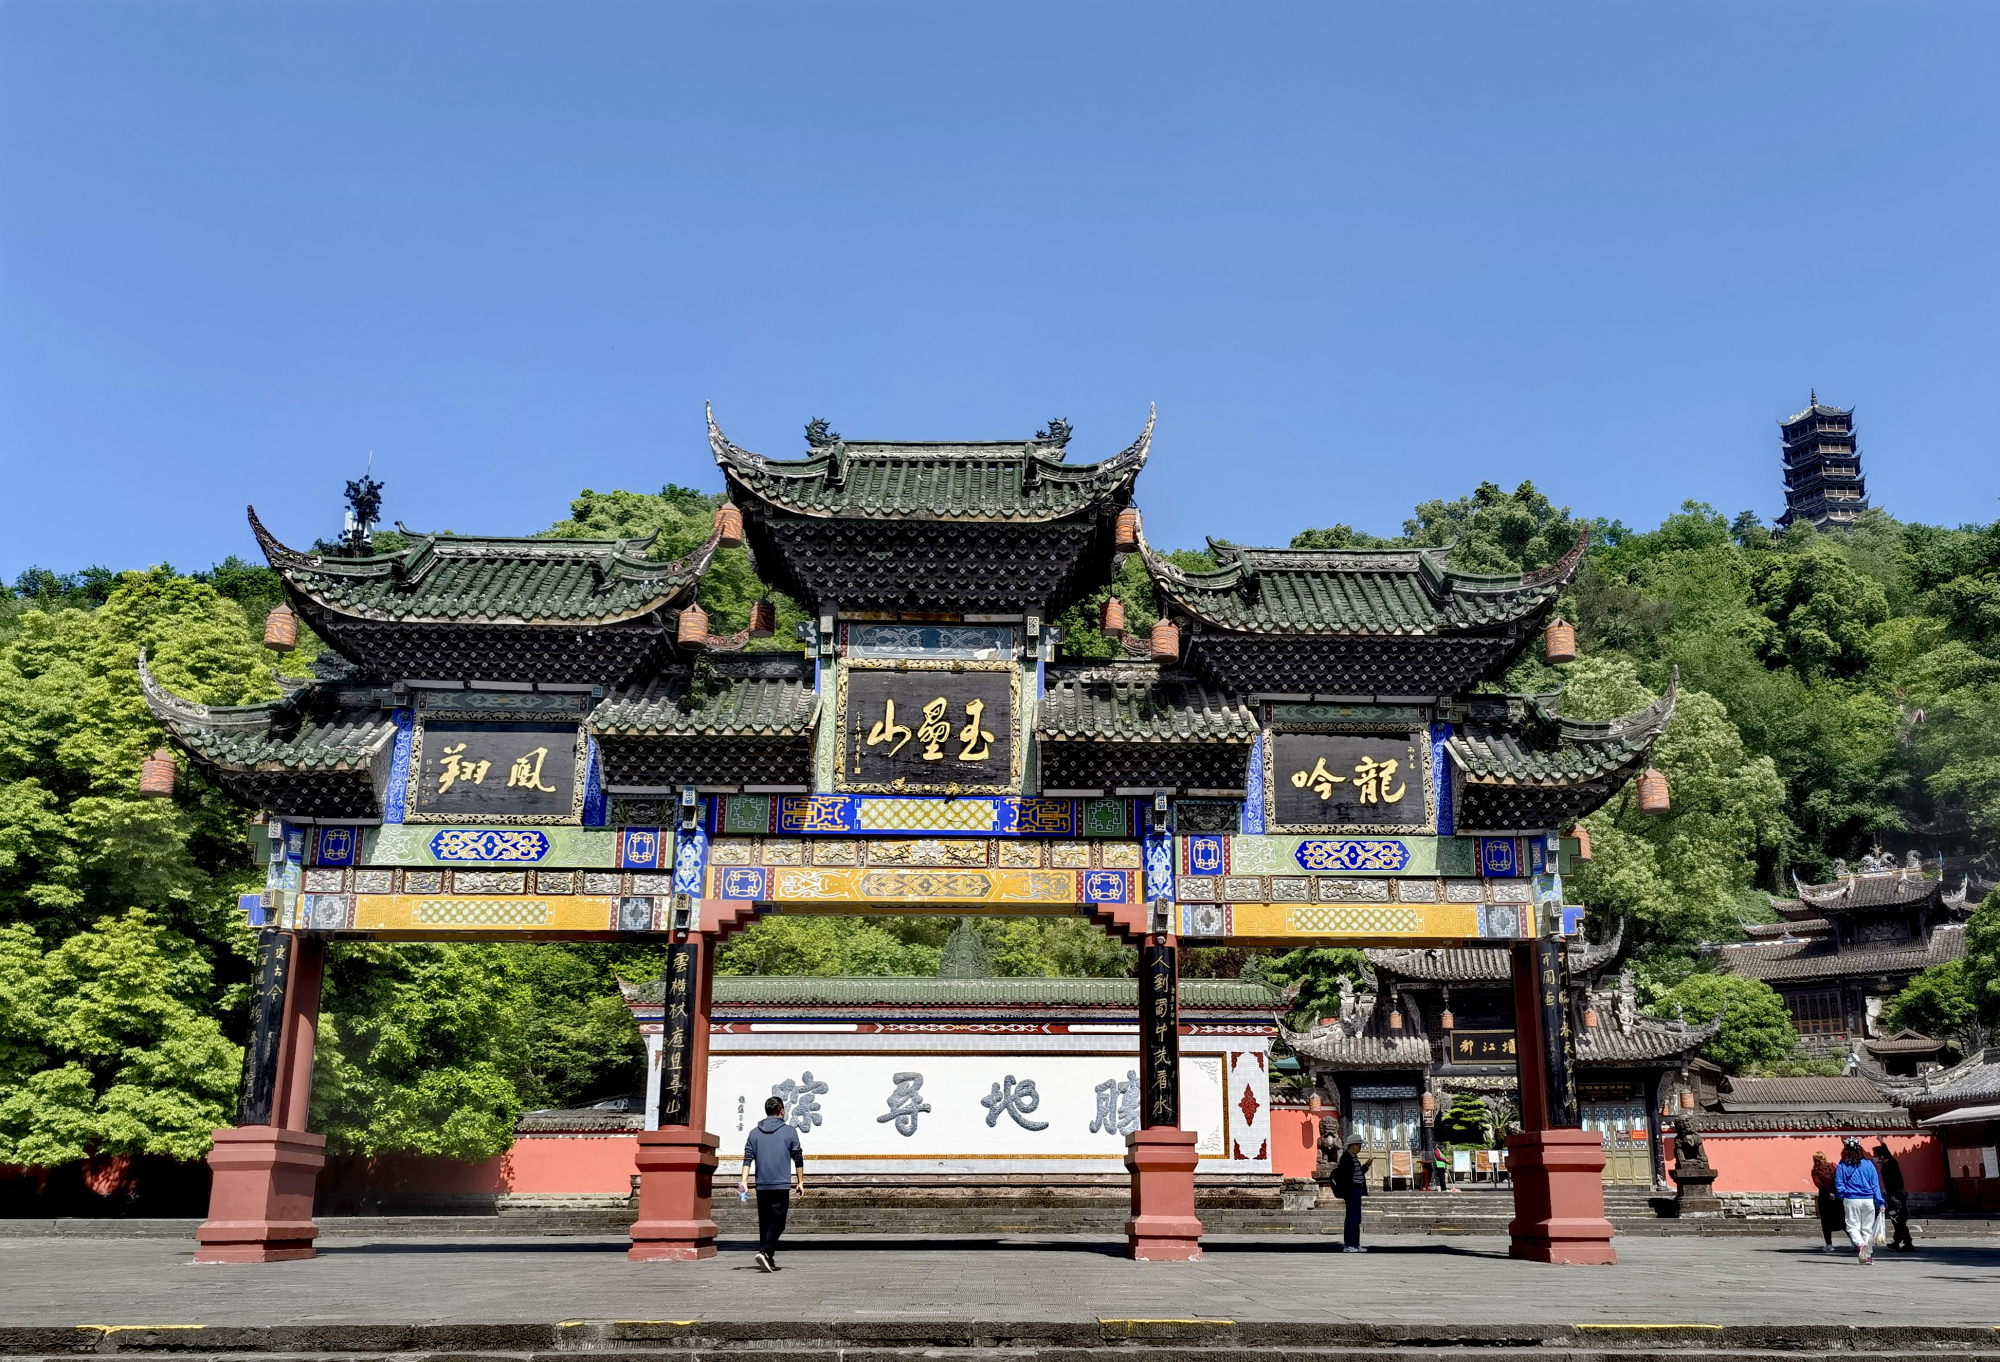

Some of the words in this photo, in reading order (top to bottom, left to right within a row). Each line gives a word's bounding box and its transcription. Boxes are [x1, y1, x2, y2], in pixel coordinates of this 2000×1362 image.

[1150, 955, 1174, 1115] 人到蜀中先看水
